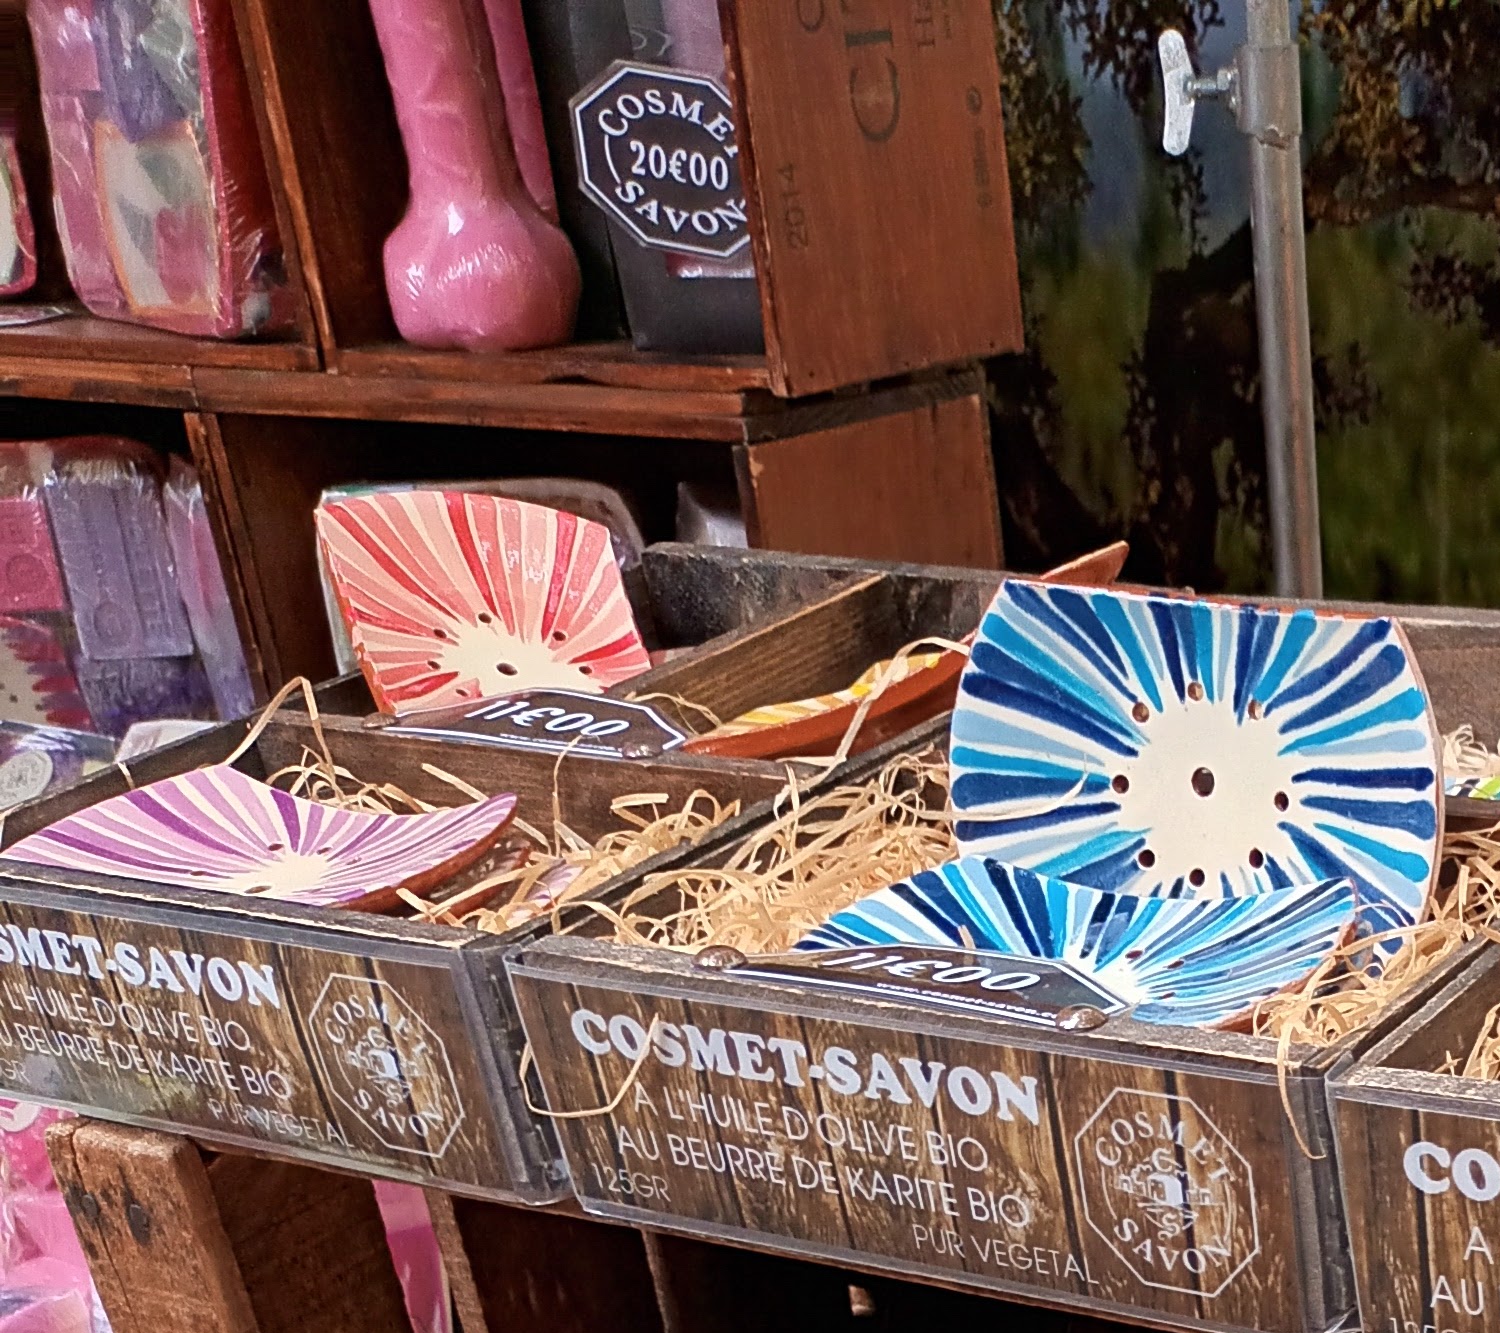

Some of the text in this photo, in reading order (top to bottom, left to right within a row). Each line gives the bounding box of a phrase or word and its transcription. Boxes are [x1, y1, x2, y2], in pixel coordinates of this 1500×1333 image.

[598, 88, 739, 158] COSME
[629, 139, 730, 192] 20€00
[614, 179, 748, 237] SAVON
[464, 700, 630, 737] 11€00
[821, 951, 1041, 992] 11€00
[14, 1022, 111, 1067] BEURRE
[110, 1040, 150, 1074] DE
[151, 1048, 242, 1092] KARITE
[241, 1065, 293, 1100] BIO
[200, 1014, 252, 1051] BIO
[570, 1008, 1040, 1126] COSMET-SAVON
[353, 1088, 446, 1138] SAVON
[634, 1080, 989, 1172] A L'HUILE D'OLIVE BIO
[1095, 1110, 1236, 1182] COSMET
[591, 1162, 672, 1203] 125GR
[617, 1125, 1031, 1229] AU BEURRE DE KARITE BIO
[912, 1223, 1100, 1285] PUR VEGETAL
[1114, 1217, 1232, 1274] SAVON
[1463, 1225, 1495, 1266] A
[1430, 1274, 1485, 1316] AU
